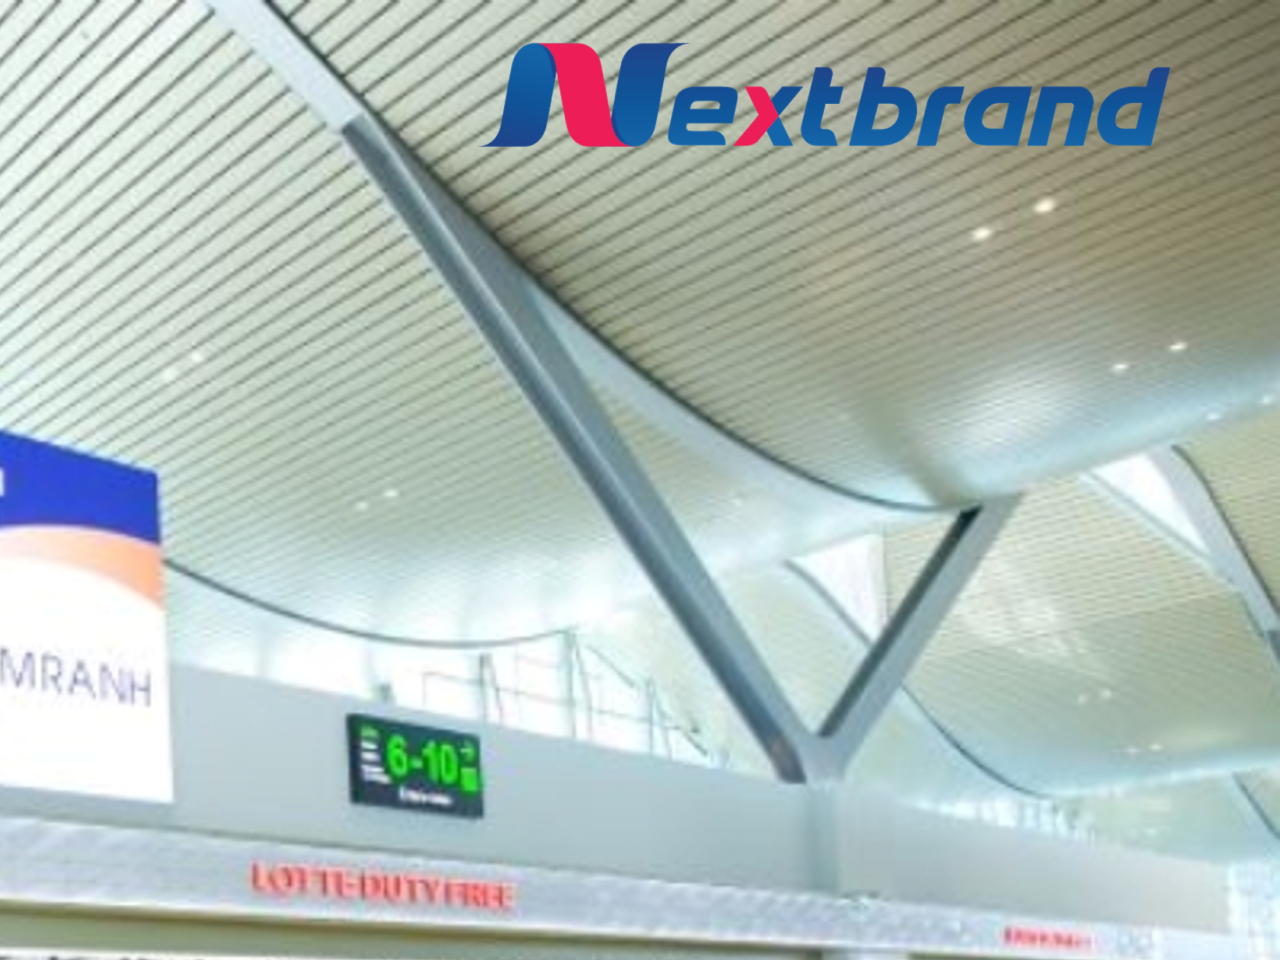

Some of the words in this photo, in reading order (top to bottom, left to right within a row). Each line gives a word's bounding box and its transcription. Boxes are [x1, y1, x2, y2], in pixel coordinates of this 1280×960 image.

[386, 734, 459, 784] 6-10
[250, 863, 358, 900] LOTTE
[360, 869, 441, 904] DUTY
